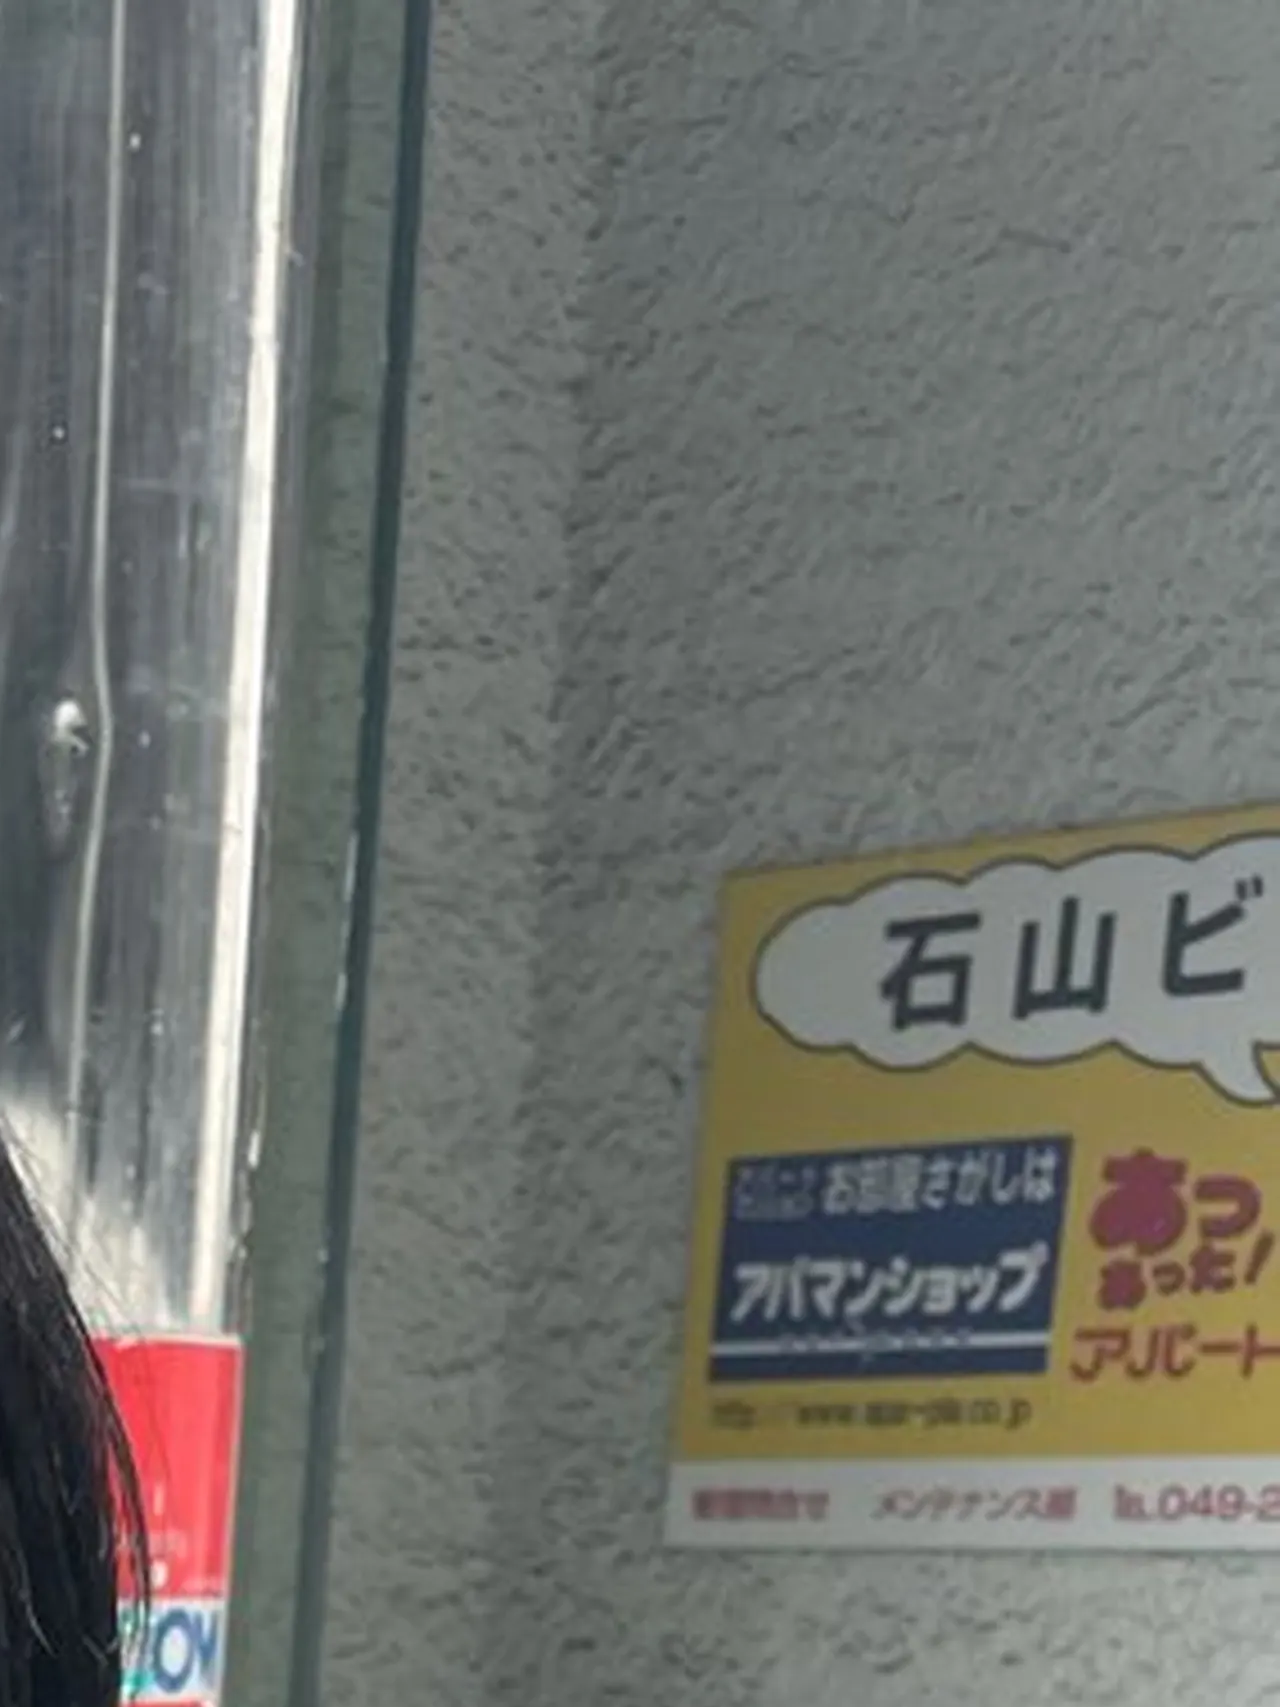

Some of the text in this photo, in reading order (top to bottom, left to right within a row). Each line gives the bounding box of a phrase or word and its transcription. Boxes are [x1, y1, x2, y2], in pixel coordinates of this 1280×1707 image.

[880, 875, 1264, 1030] 石山ビ
[729, 1240, 1049, 1322] アパマンショップ
